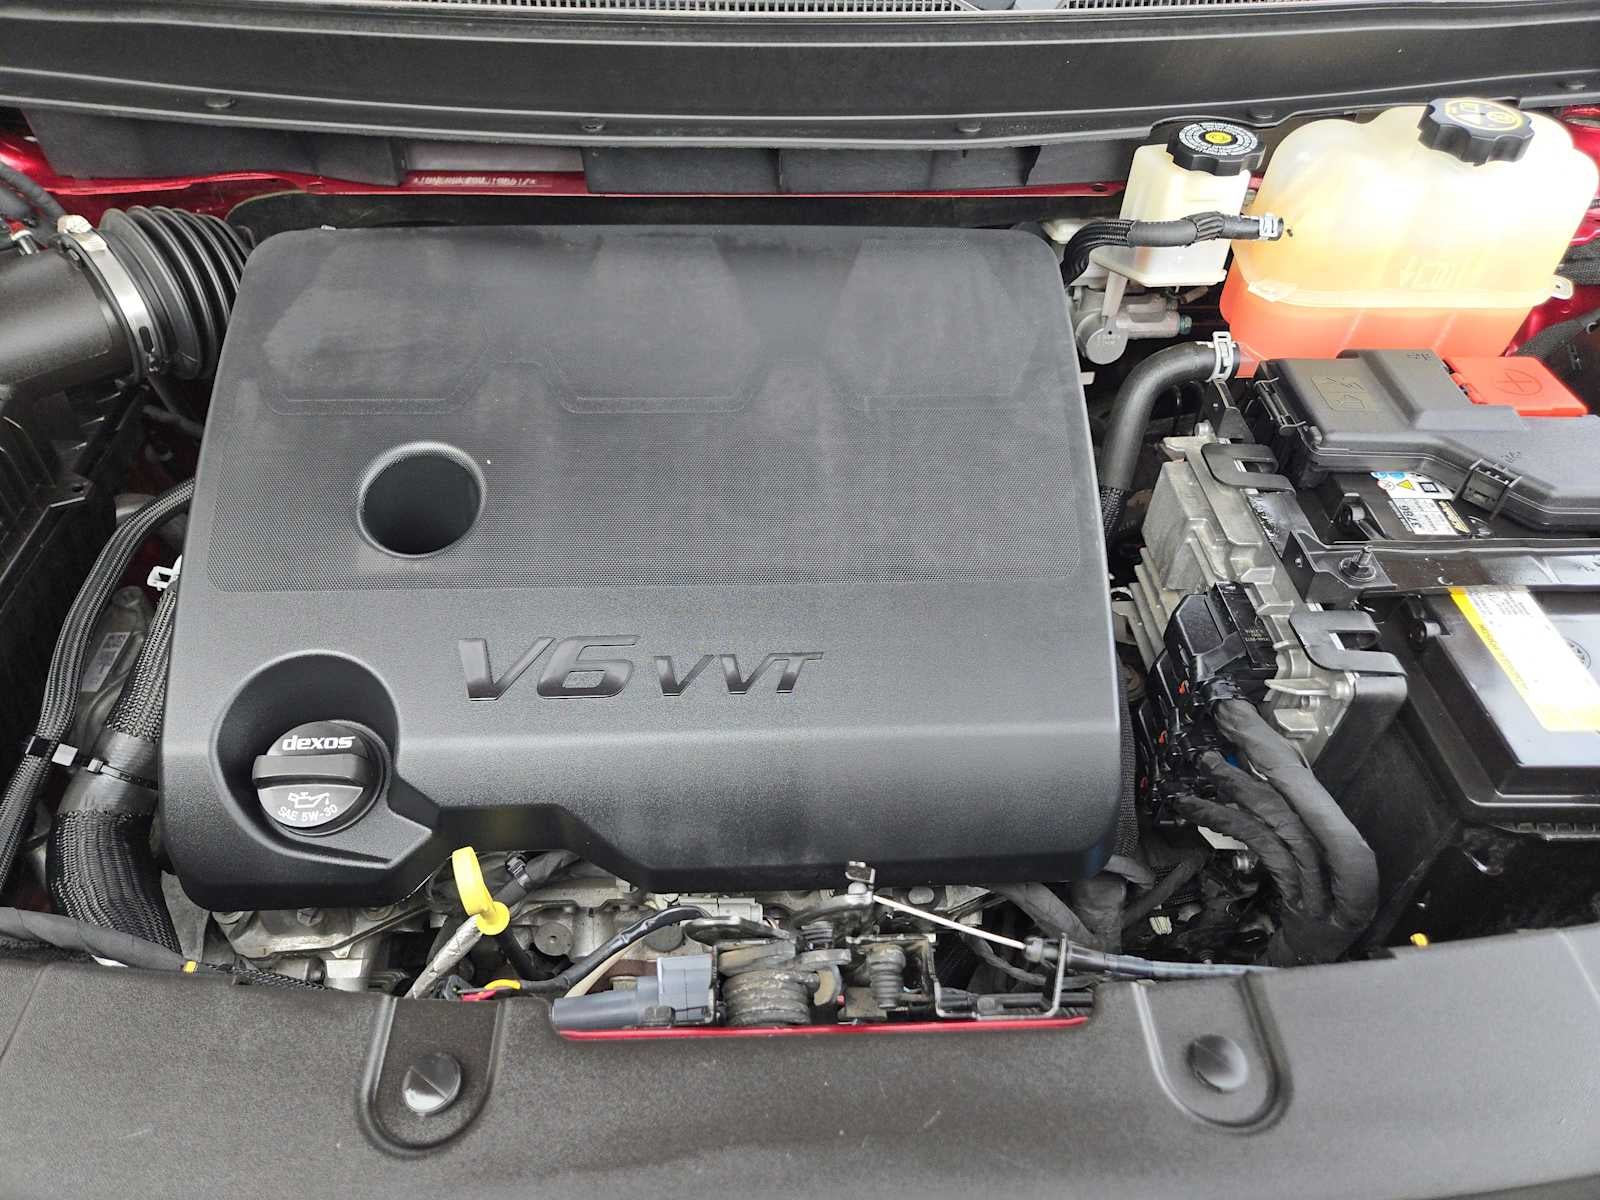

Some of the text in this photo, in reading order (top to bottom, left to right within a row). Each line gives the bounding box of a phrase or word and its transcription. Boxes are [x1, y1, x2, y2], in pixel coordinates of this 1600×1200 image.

[458, 635, 824, 701] V6 VVT
[282, 735, 356, 751] dexos
[278, 804, 338, 822] SAE 5W-30
